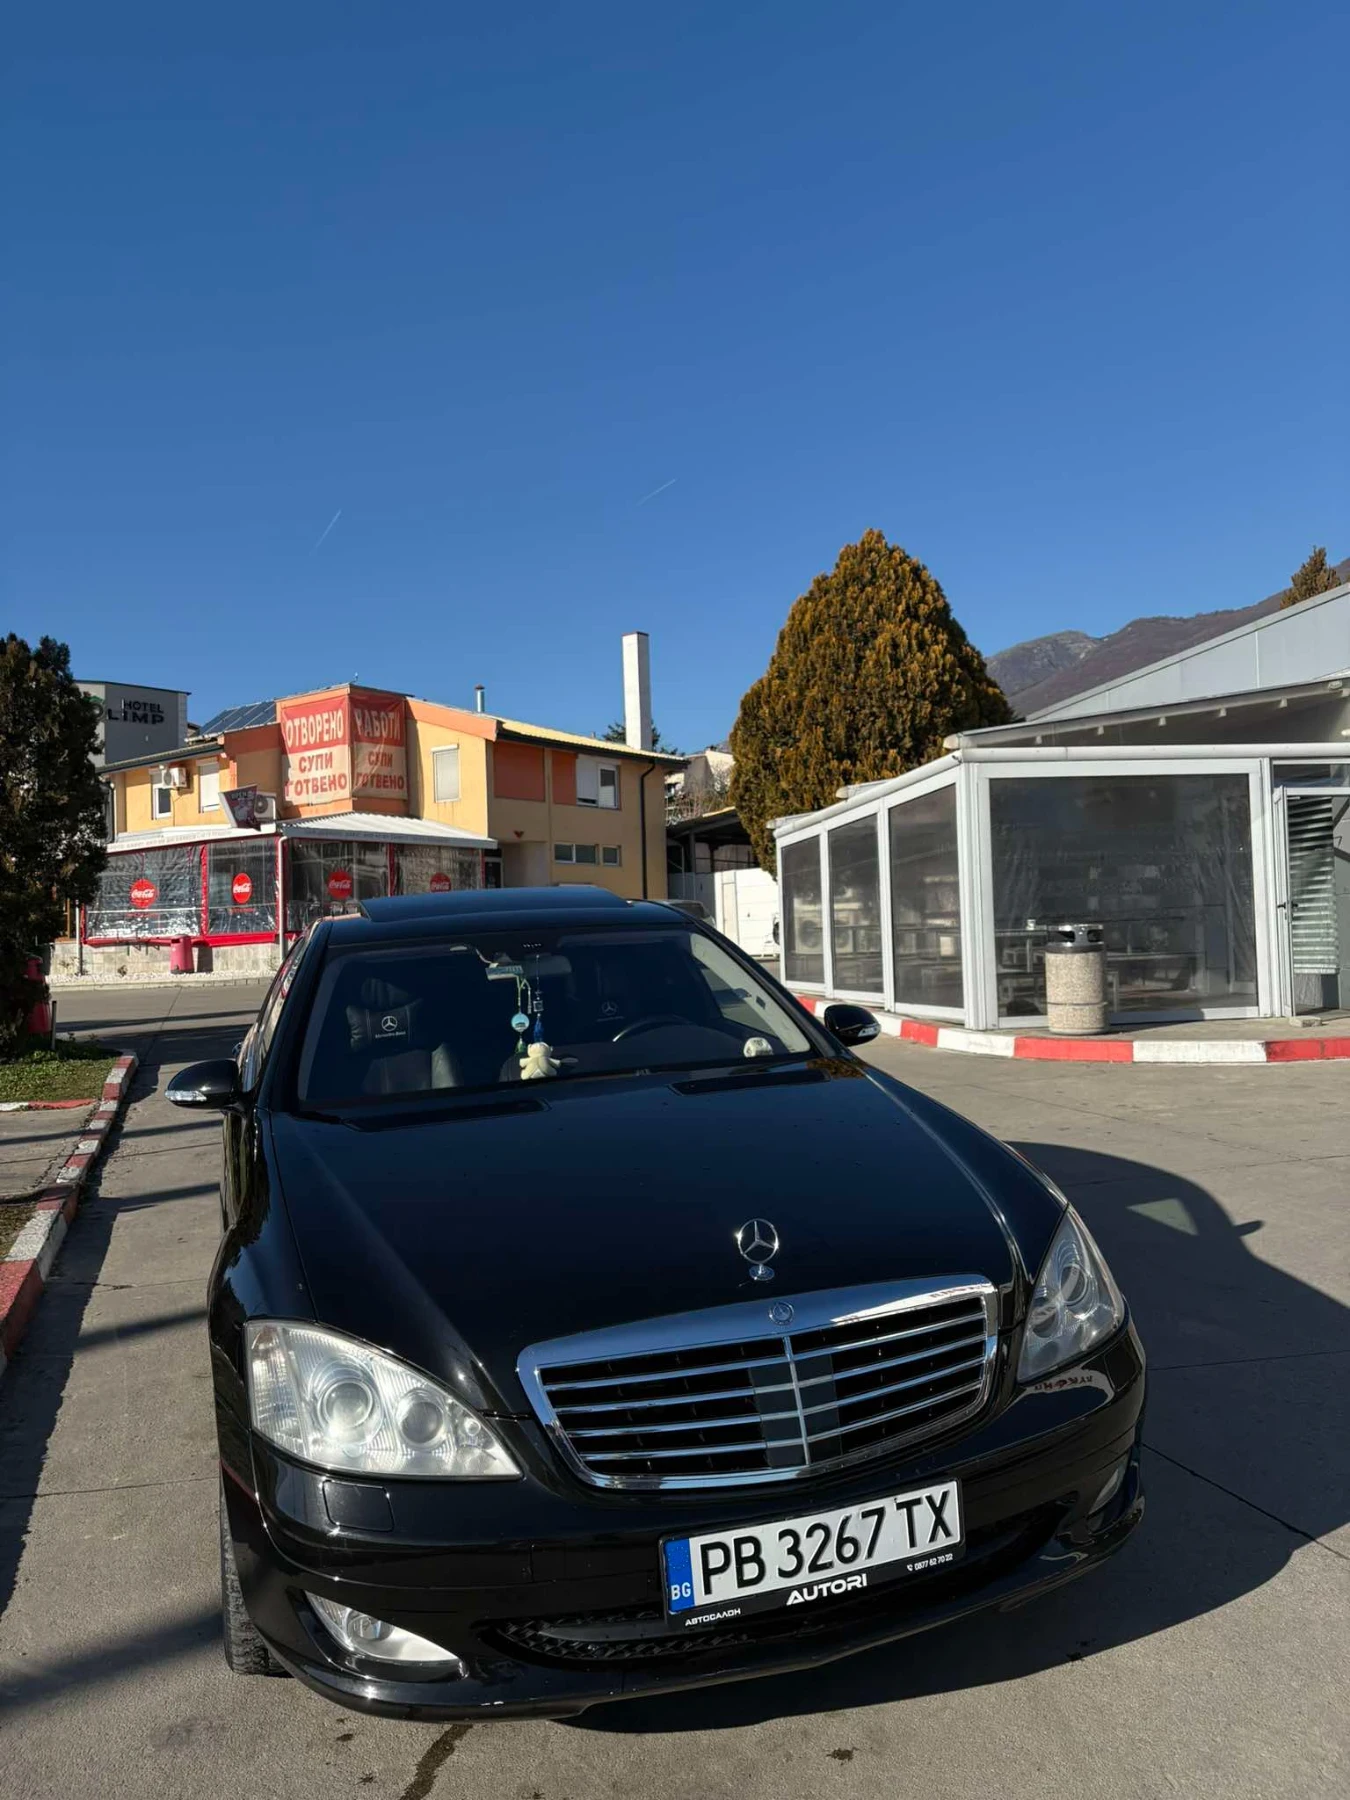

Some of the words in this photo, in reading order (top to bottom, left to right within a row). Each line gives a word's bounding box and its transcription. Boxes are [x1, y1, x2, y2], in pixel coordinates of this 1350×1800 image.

[124, 700, 164, 714] HOTEL
[285, 709, 344, 748] ОТВОРЕНО
[298, 752, 333, 774] СУПИ
[367, 751, 393, 768] СУПИ
[284, 773, 348, 797] ГОТВЕНО
[354, 772, 405, 791] ГОТВЕНО
[700, 1536, 766, 1596] PB
[777, 1507, 885, 1579] 3267
[896, 1491, 953, 1549] TX
[671, 1582, 692, 1601] BG
[786, 1573, 868, 1606] AUTORI
[685, 1608, 742, 1627] АВТОСАЛОН
